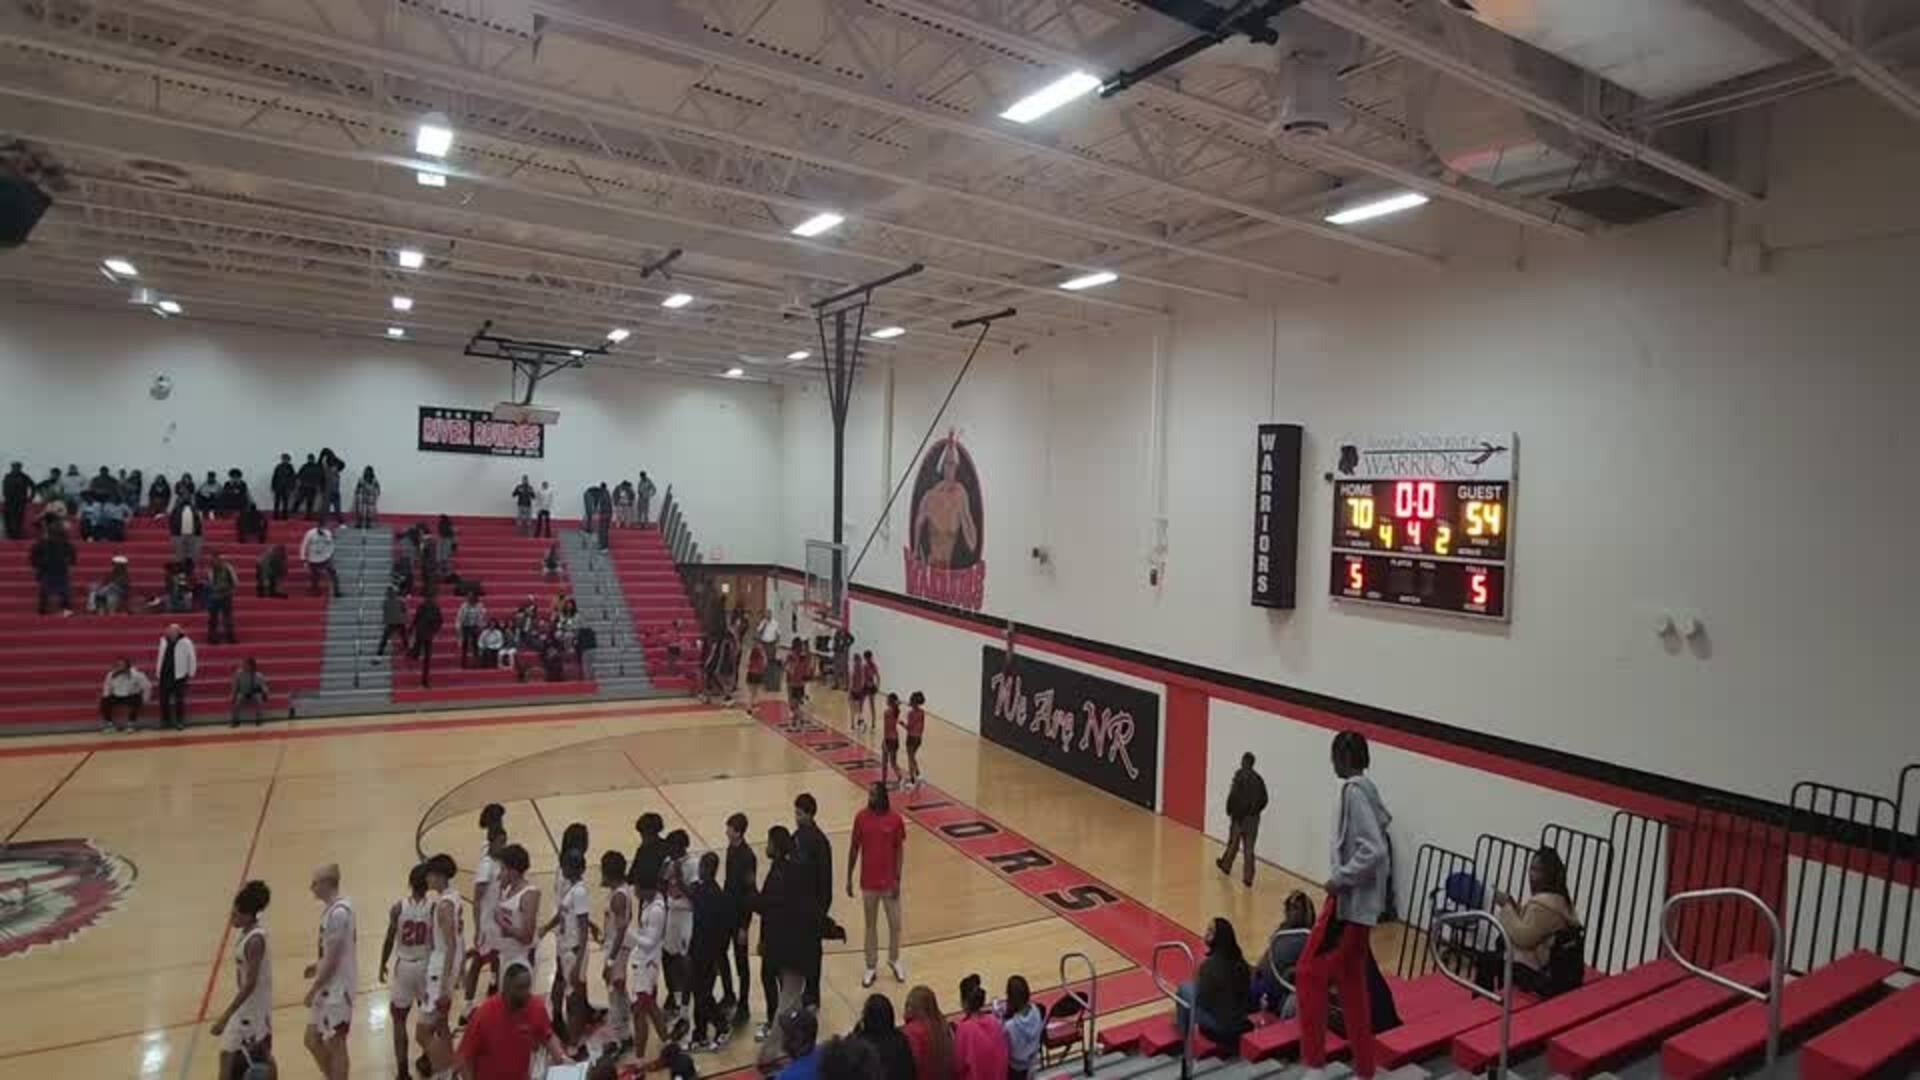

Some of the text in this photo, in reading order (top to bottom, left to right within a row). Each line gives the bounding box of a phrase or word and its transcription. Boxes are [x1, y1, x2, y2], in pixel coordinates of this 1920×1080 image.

[423, 416, 471, 445] RIVER
[1364, 454, 1478, 477] WARRIORS
[1340, 483, 1373, 497] HOME
[1457, 485, 1503, 500] GUEST
[1257, 433, 1276, 593] WARRIORS
[1347, 498, 1501, 535] 70 54
[1378, 520, 1451, 555] 4 4 2
[1350, 563, 1487, 604] 5 5
[990, 672, 1139, 780] We Are NR
